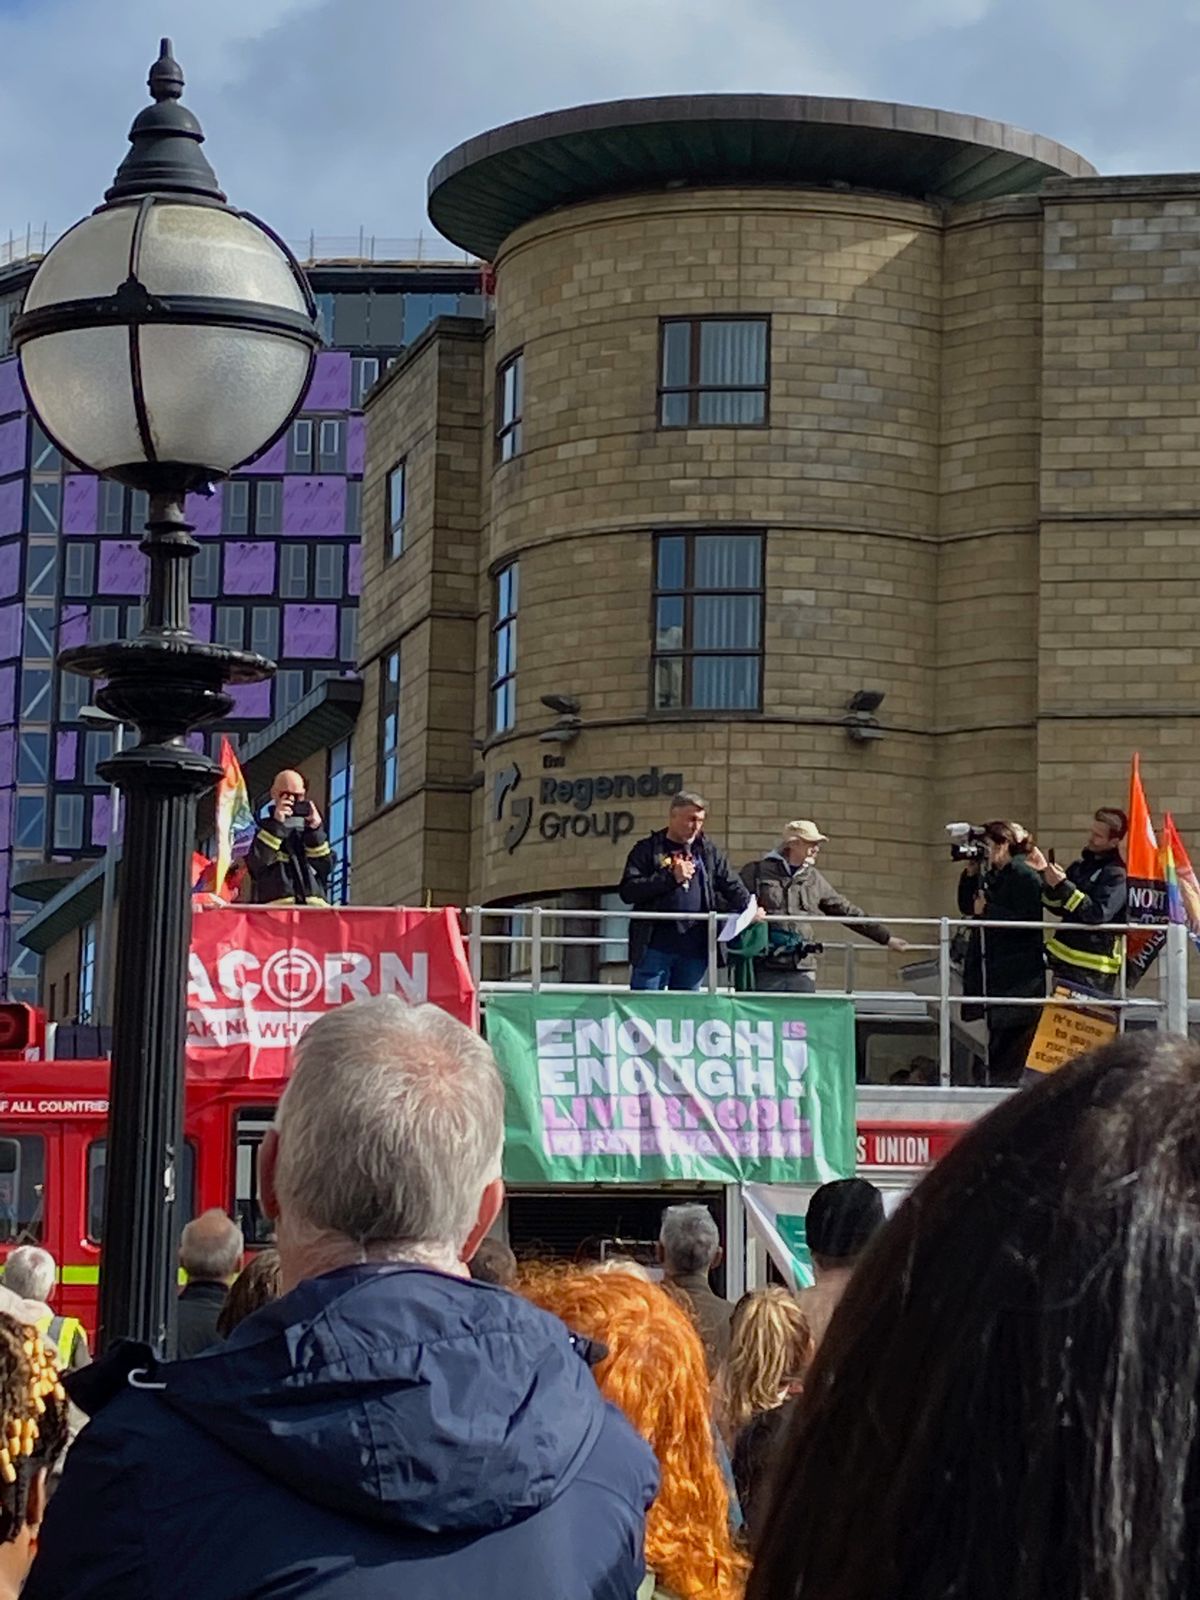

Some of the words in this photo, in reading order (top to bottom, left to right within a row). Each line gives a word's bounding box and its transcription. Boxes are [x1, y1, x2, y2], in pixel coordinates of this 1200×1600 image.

[540, 767, 683, 811] Regenda
[540, 811, 634, 844] Group
[535, 1018, 774, 1058] ENOUGH
[782, 1021, 807, 1038] IS
[10, 1101, 36, 1112] ALL
[541, 1095, 811, 1131] LIVERPOOL
[875, 1135, 929, 1163] UNION
